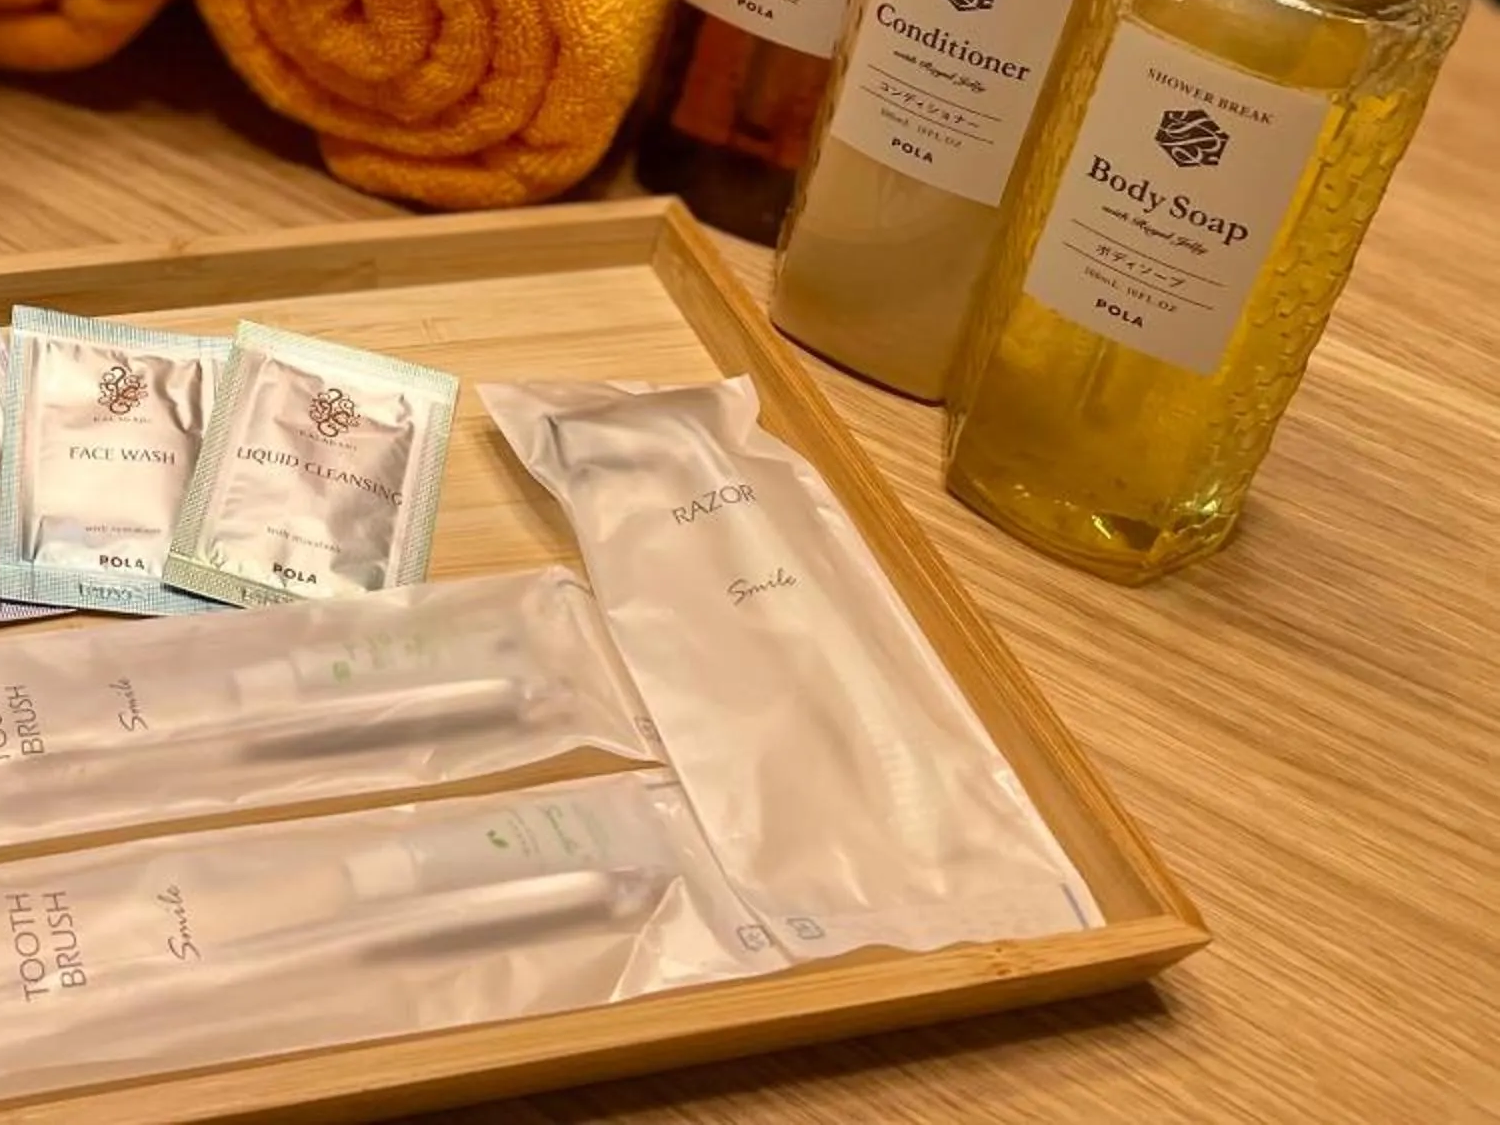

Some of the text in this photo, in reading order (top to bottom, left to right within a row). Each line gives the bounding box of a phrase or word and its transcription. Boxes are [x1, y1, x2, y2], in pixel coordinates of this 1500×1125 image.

[876, 2, 1032, 82] Conditioner
[1147, 67, 1274, 125] SHOWER BREAK
[891, 137, 934, 164] POLA
[1084, 154, 1250, 246] Body Soap
[1094, 298, 1145, 328] POLA
[69, 446, 177, 465] FACE WASH
[237, 445, 404, 507] LIQUID CLEANSING
[672, 484, 756, 524] RAZOR
[99, 554, 145, 570] POLA
[272, 561, 318, 585] POLA
[727, 567, 797, 606] Smile
[5, 684, 45, 756] BRUSH
[108, 677, 149, 732] Smile
[5, 892, 49, 1002] TOOTH
[42, 891, 88, 989] BRUSH
[156, 884, 200, 960] Smile
